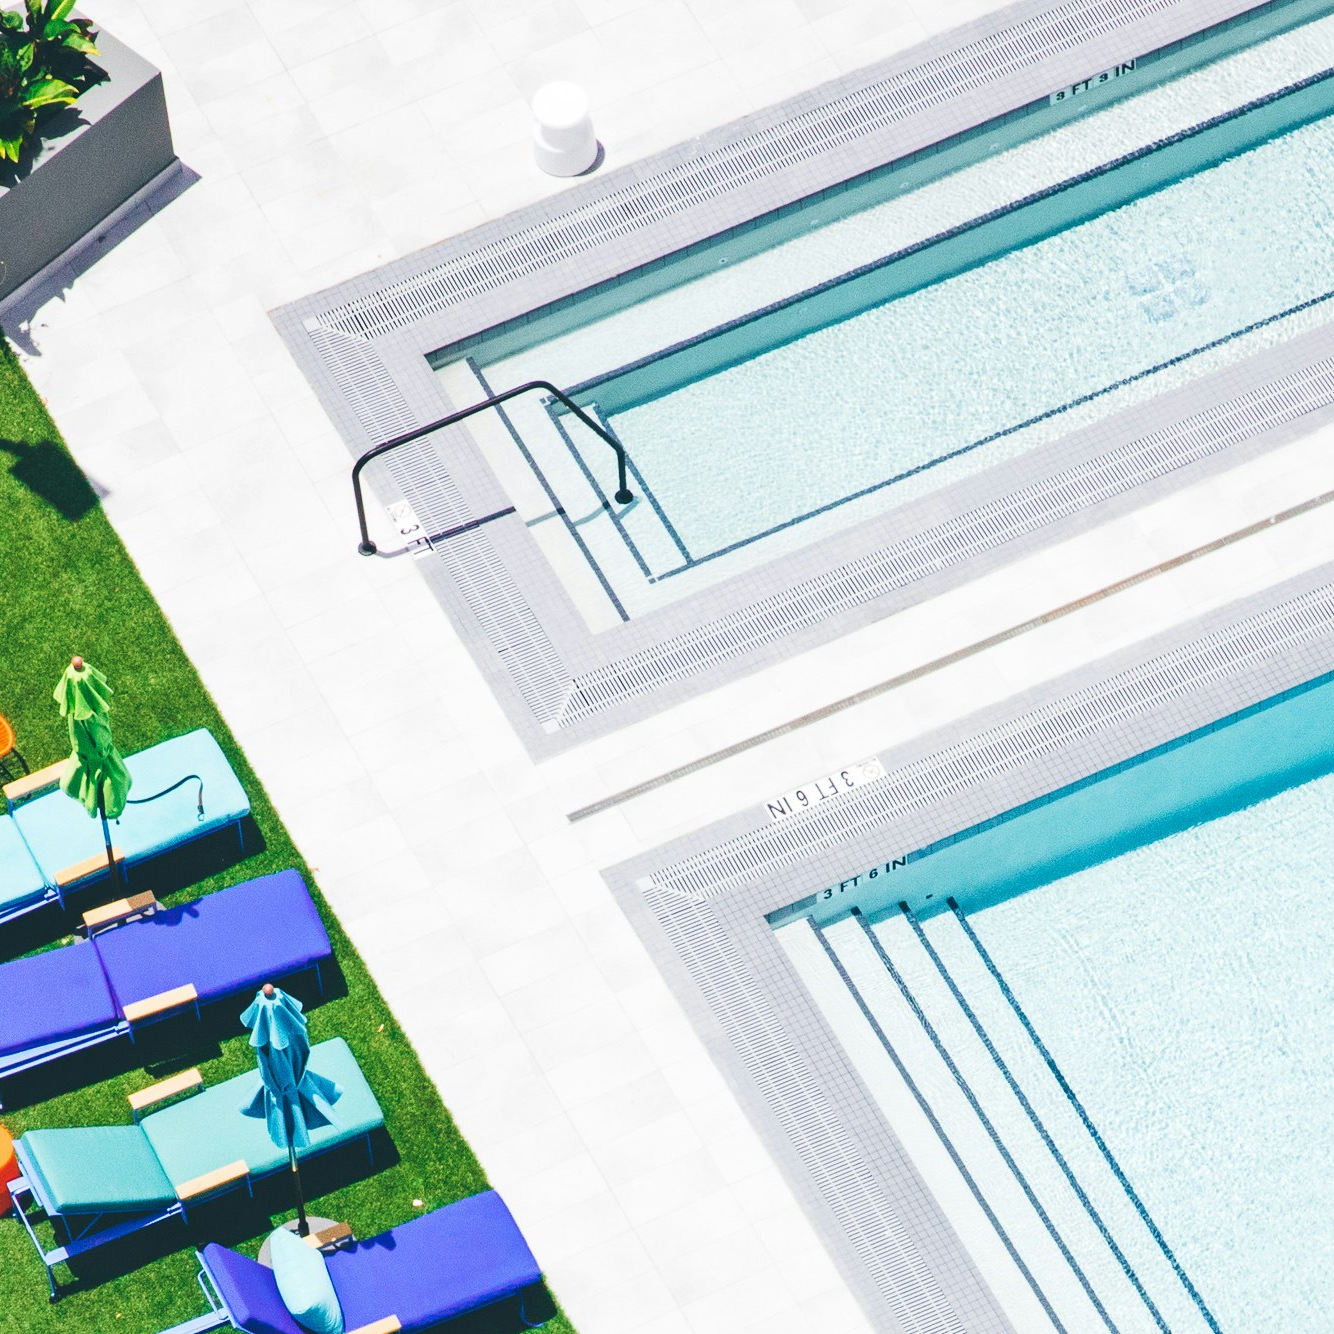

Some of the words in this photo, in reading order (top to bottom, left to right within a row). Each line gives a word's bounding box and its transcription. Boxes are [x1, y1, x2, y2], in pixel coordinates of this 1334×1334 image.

[1056, 91, 1066, 101] 3
[1072, 78, 1093, 96] FT
[1115, 59, 1136, 78] IN
[400, 524, 420, 535] 3
[407, 536, 434, 555] FT
[815, 777, 839, 801] FT
[840, 770, 855, 788] 3
[766, 797, 793, 819] IN
[796, 790, 809, 807] 6
[823, 888, 833, 900] 3
[840, 875, 861, 893] FT
[869, 868, 879, 879] 6
[885, 855, 907, 873] IN
